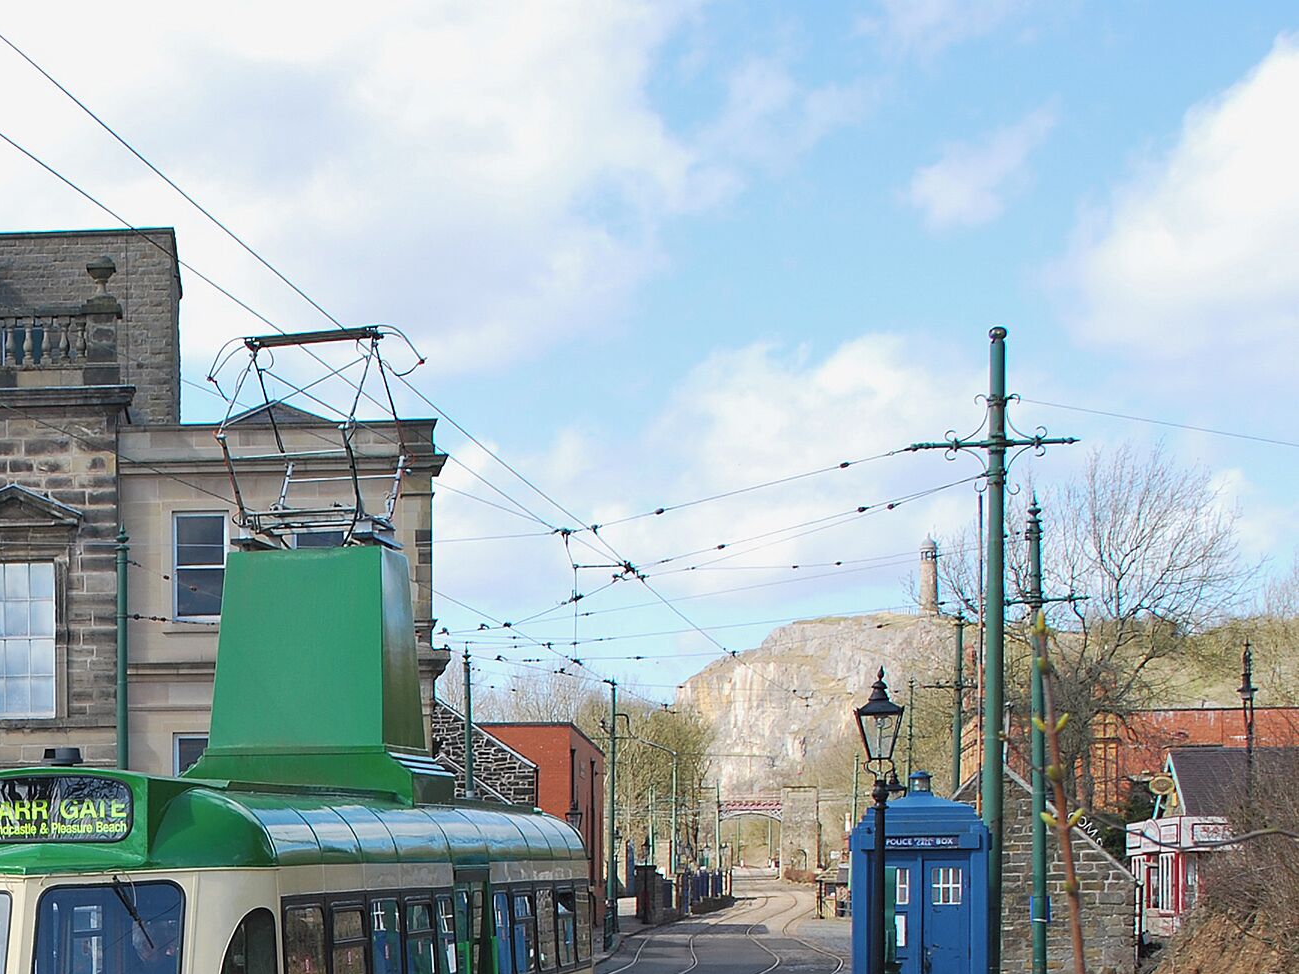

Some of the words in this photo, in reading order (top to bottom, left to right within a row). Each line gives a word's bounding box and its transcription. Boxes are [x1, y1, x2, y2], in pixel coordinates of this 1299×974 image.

[40, 824, 49, 834] &
[51, 823, 93, 834] Pleasure
[96, 821, 127, 833] Beach
[885, 838, 913, 846] POLICE
[936, 837, 954, 845] BOX
